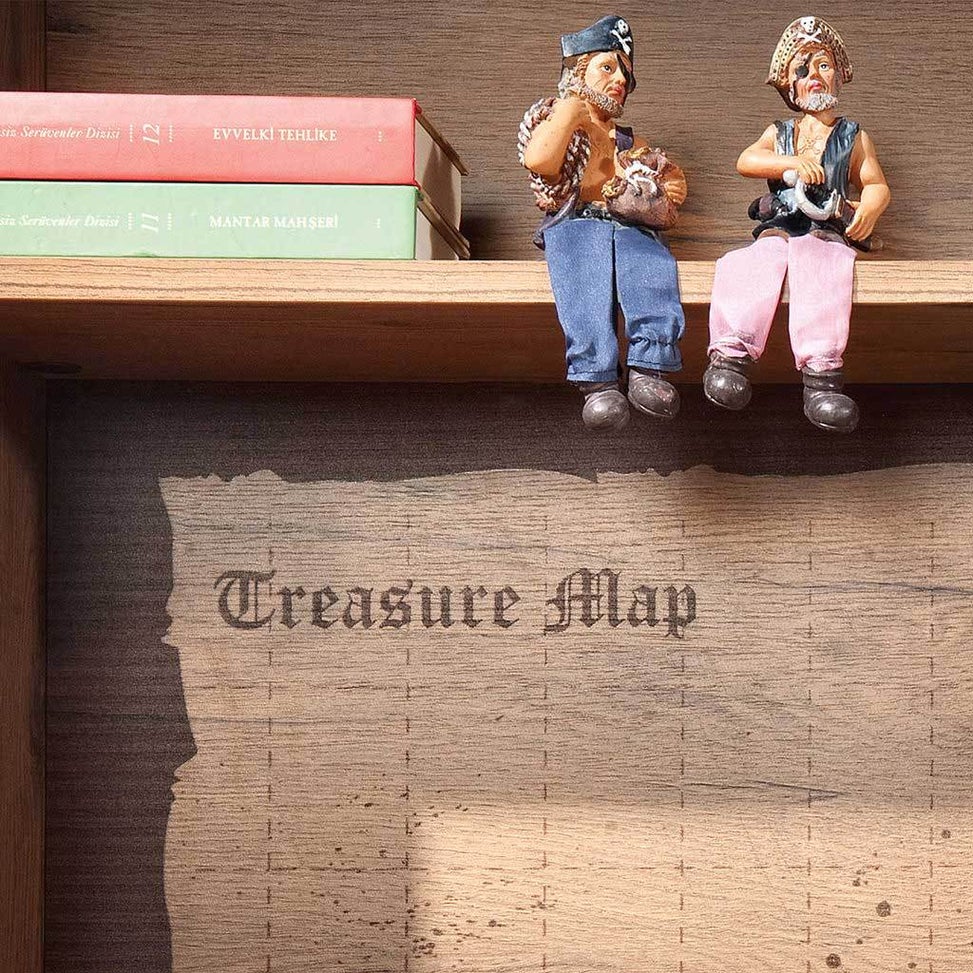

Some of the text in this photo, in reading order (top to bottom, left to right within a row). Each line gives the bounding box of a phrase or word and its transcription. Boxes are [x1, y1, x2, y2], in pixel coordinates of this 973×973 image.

[143, 123, 161, 145] 12
[212, 126, 274, 141] EVVELKİ
[278, 127, 338, 143] TEHLİKE
[141, 212, 159, 233] 11
[209, 215, 271, 229] MANTAR
[274, 214, 339, 232] MAHŞERİ
[213, 567, 698, 639] Treasure Map
